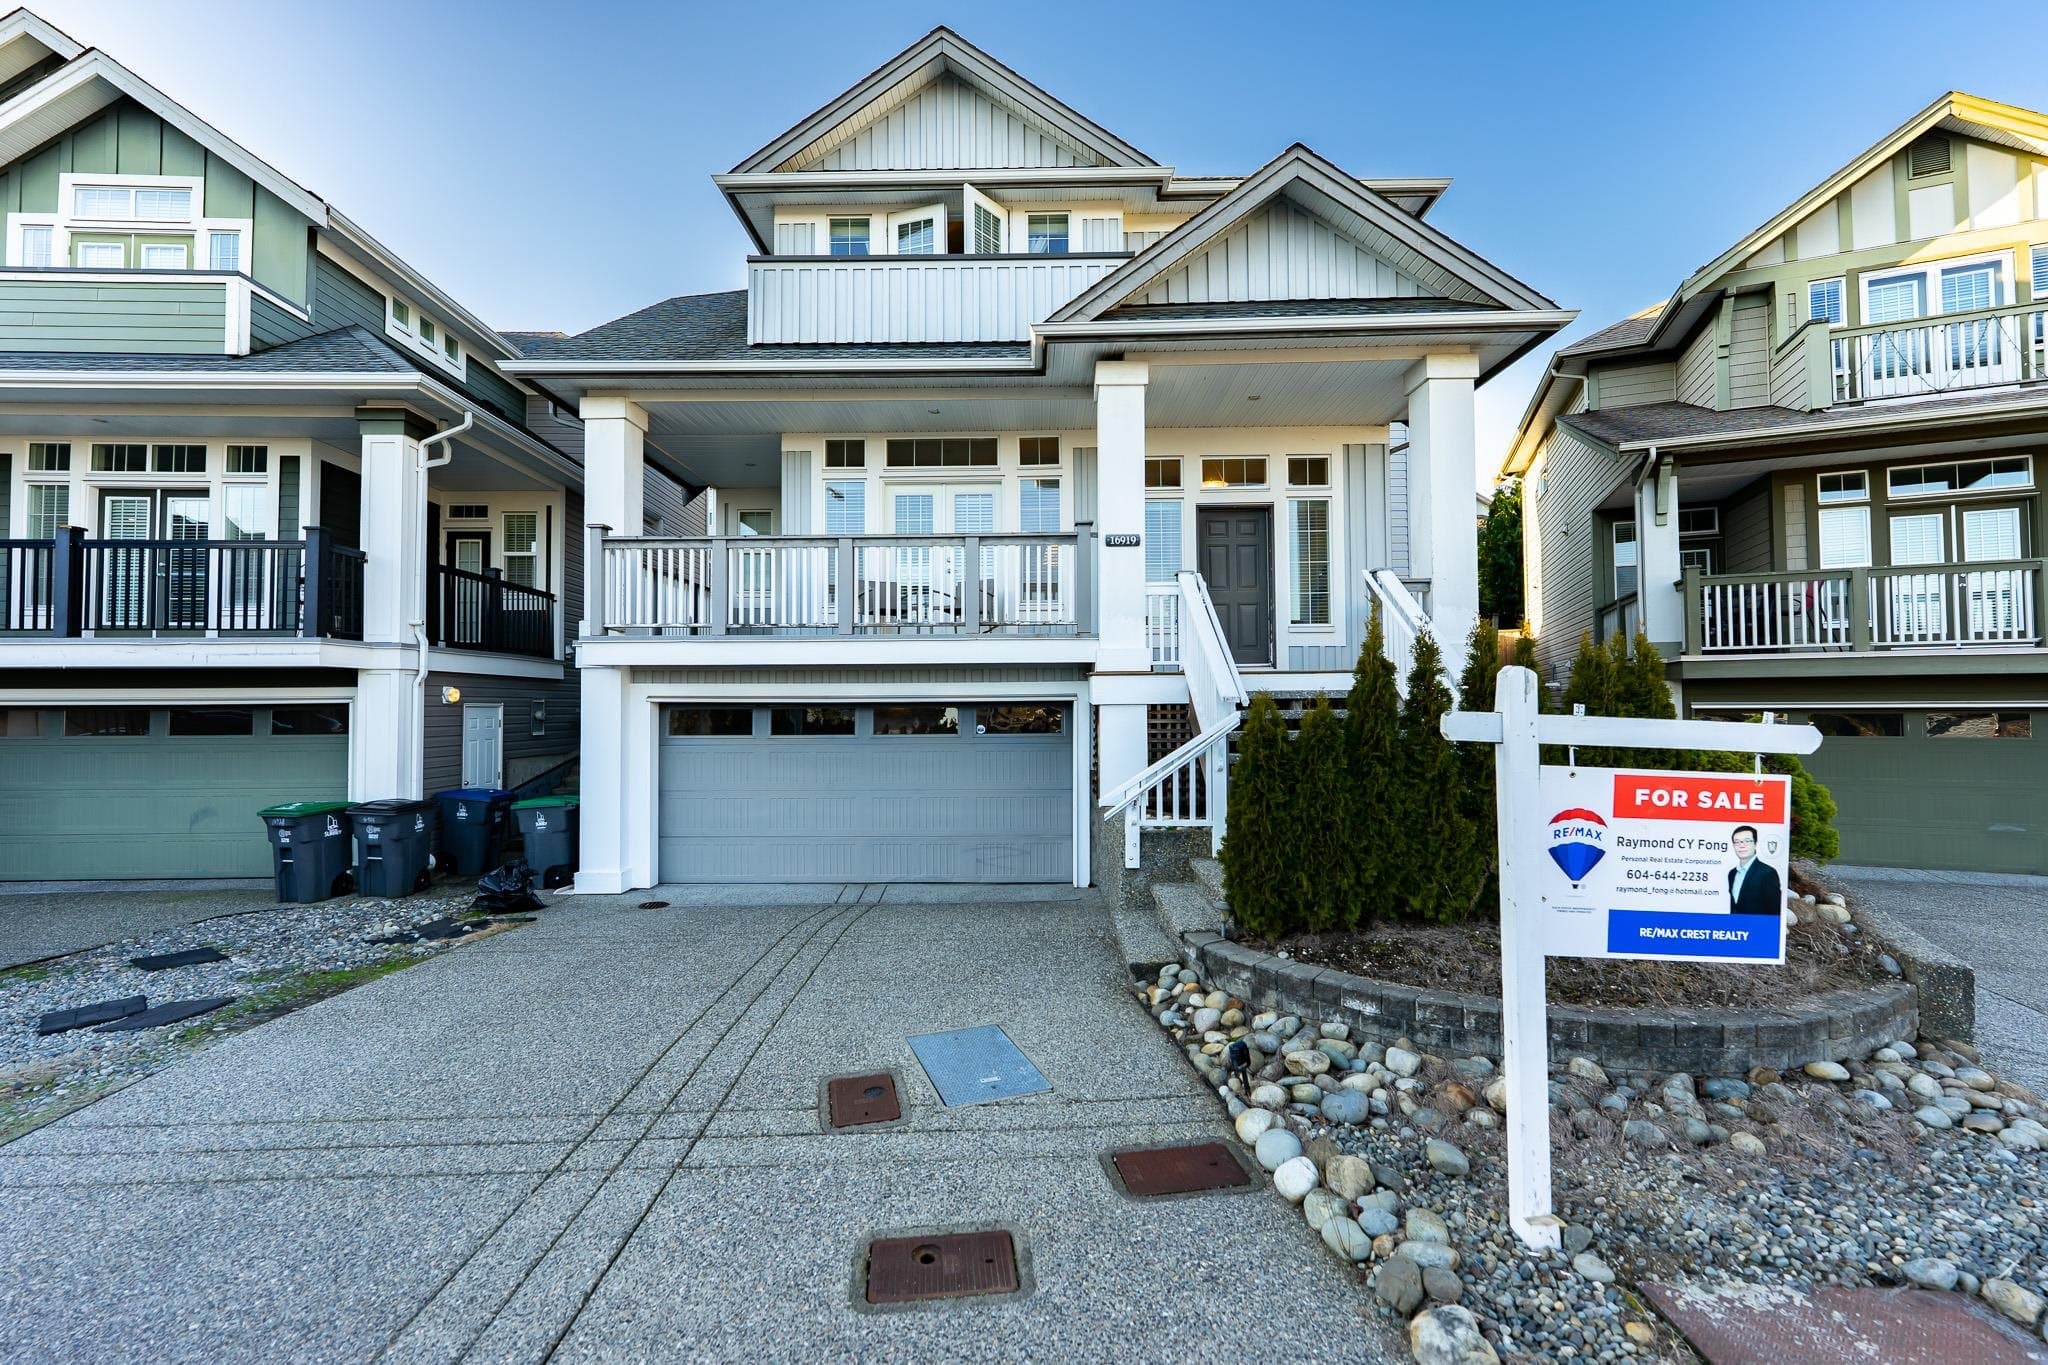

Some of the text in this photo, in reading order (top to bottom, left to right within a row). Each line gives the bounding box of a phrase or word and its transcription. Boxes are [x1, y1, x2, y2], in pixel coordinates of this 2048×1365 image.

[1110, 535, 1137, 545] 16919
[1635, 788, 1765, 811] FOR SALE
[1553, 826, 1603, 842] RE/MAX
[1616, 836, 1728, 853] Raymond CY Fong
[1626, 869, 1709, 882] 604-644-2238
[1616, 886, 1720, 896] raymond_fong@hotmail.com
[1639, 927, 1749, 941] RE/MAX CREST REALTY
